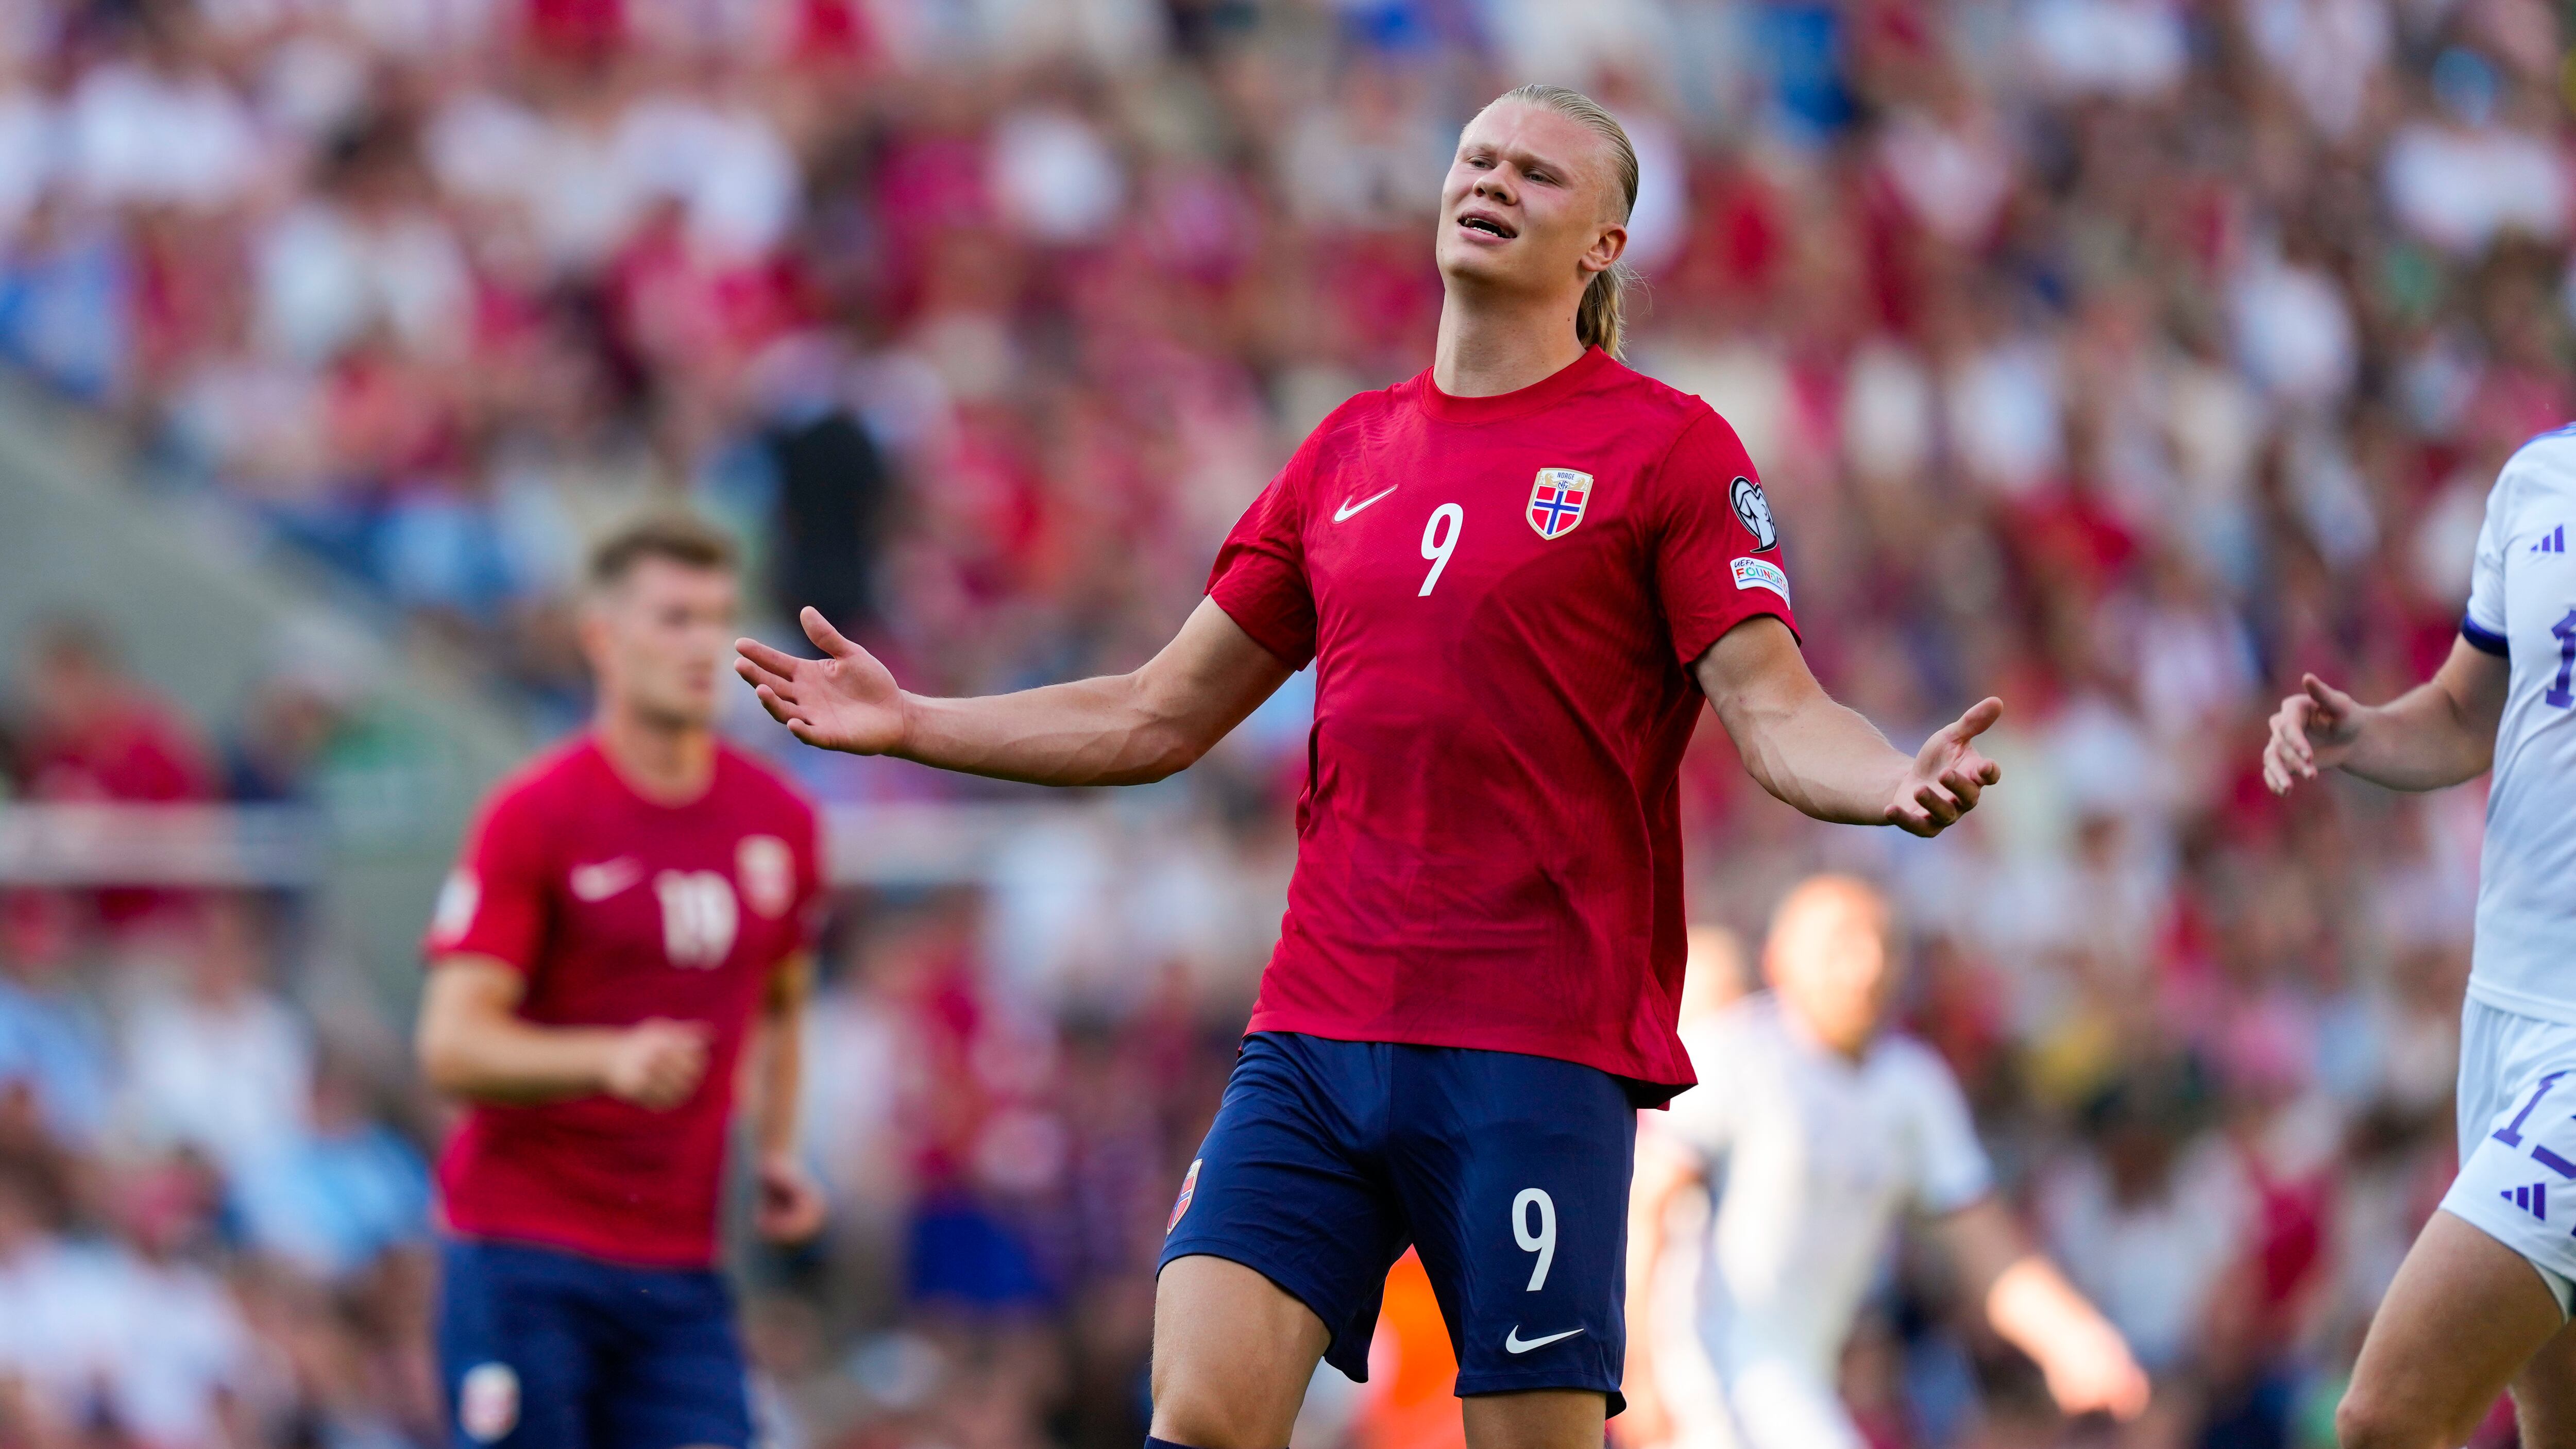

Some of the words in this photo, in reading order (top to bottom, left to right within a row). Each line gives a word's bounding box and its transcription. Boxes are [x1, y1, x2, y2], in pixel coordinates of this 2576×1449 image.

[1418, 503, 1463, 597] 9
[1734, 559, 1755, 567] UEFA
[1736, 567, 1788, 594] FOUNDATIO
[1512, 1188, 1556, 1291] 9
